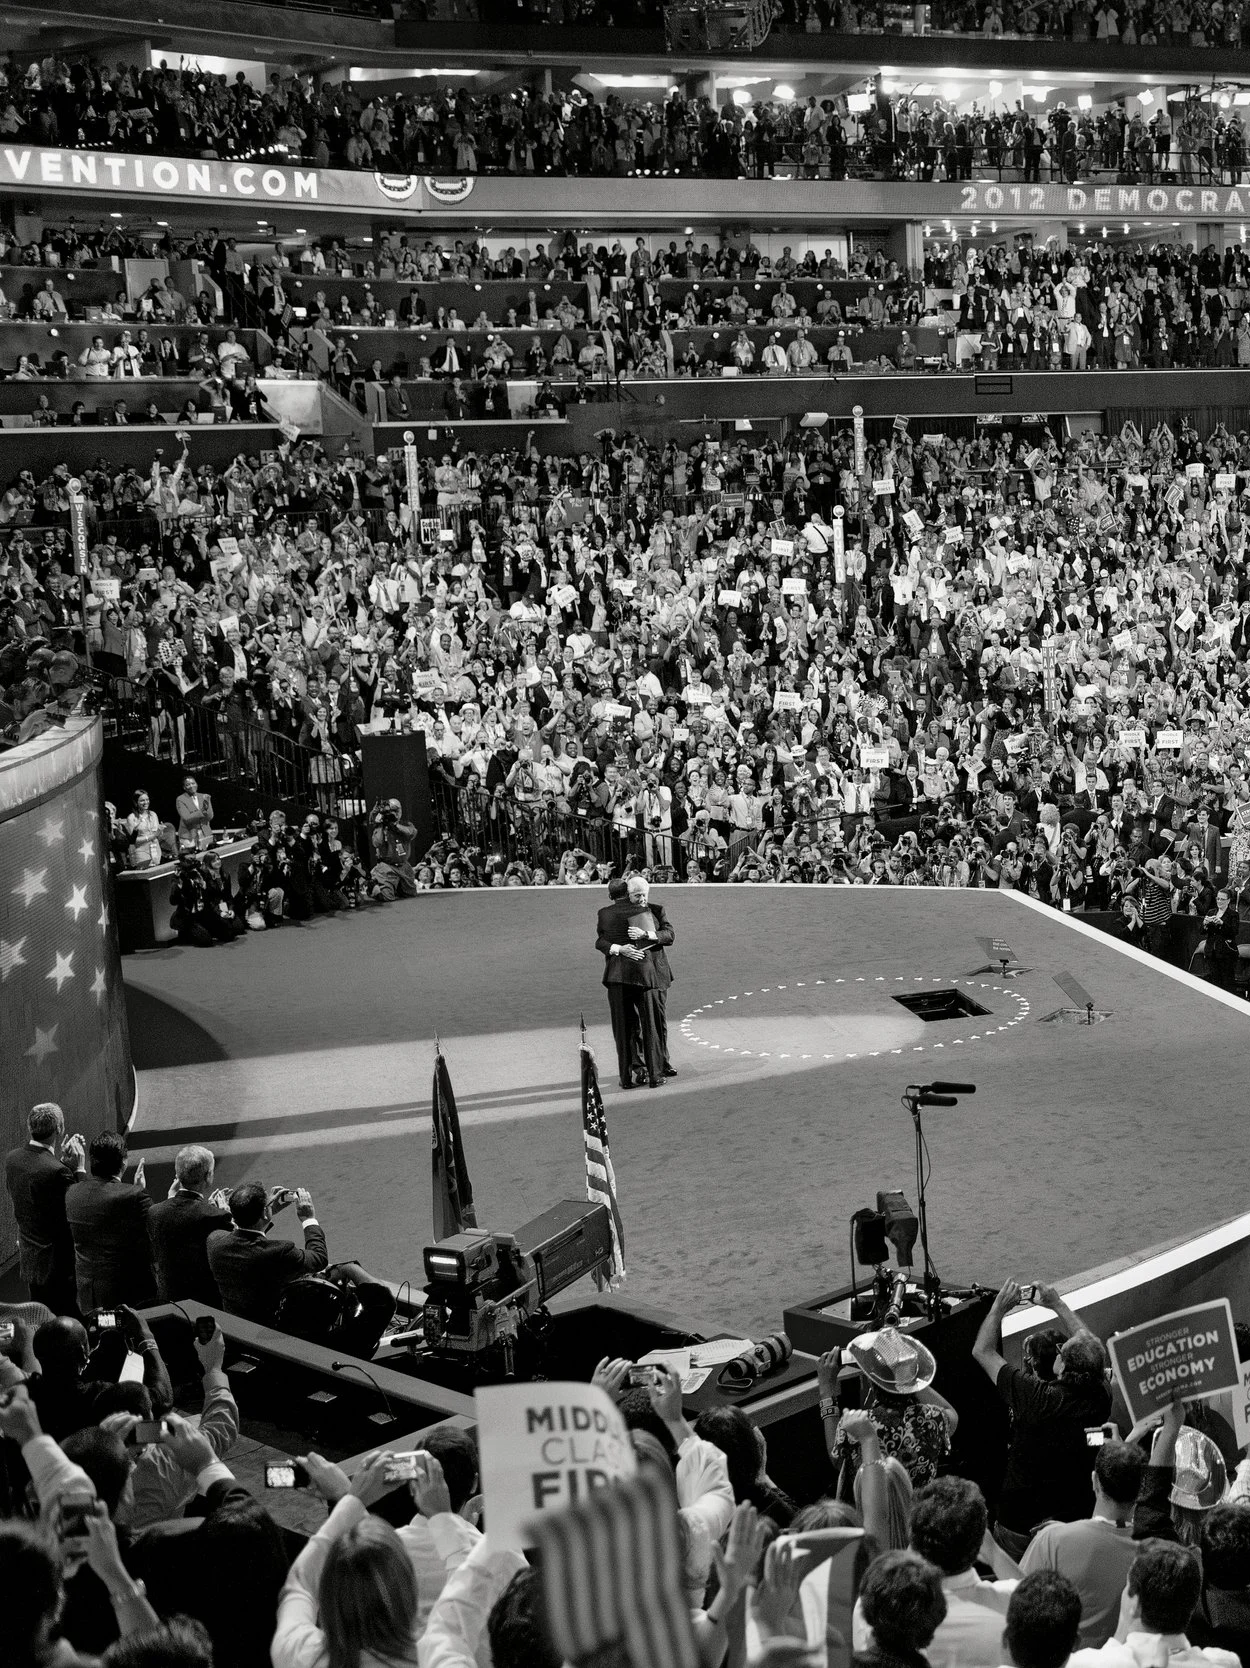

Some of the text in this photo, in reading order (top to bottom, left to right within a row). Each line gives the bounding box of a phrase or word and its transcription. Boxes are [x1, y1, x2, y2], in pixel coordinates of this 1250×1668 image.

[5, 149, 319, 199] VENTION.COM
[960, 186, 1046, 210] 2012
[74, 503, 87, 573] WISCONSIN
[1048, 647, 1056, 711] HAWAII
[1127, 1330, 1219, 1373] EDUCATION
[1146, 1327, 1190, 1347] STRONGER
[1139, 1356, 1215, 1396] ECONOMY
[1150, 1352, 1194, 1373] STRONGER
[526, 1405, 609, 1434] MIDD
[541, 1436, 607, 1466] CLA
[532, 1468, 611, 1510] FIR
